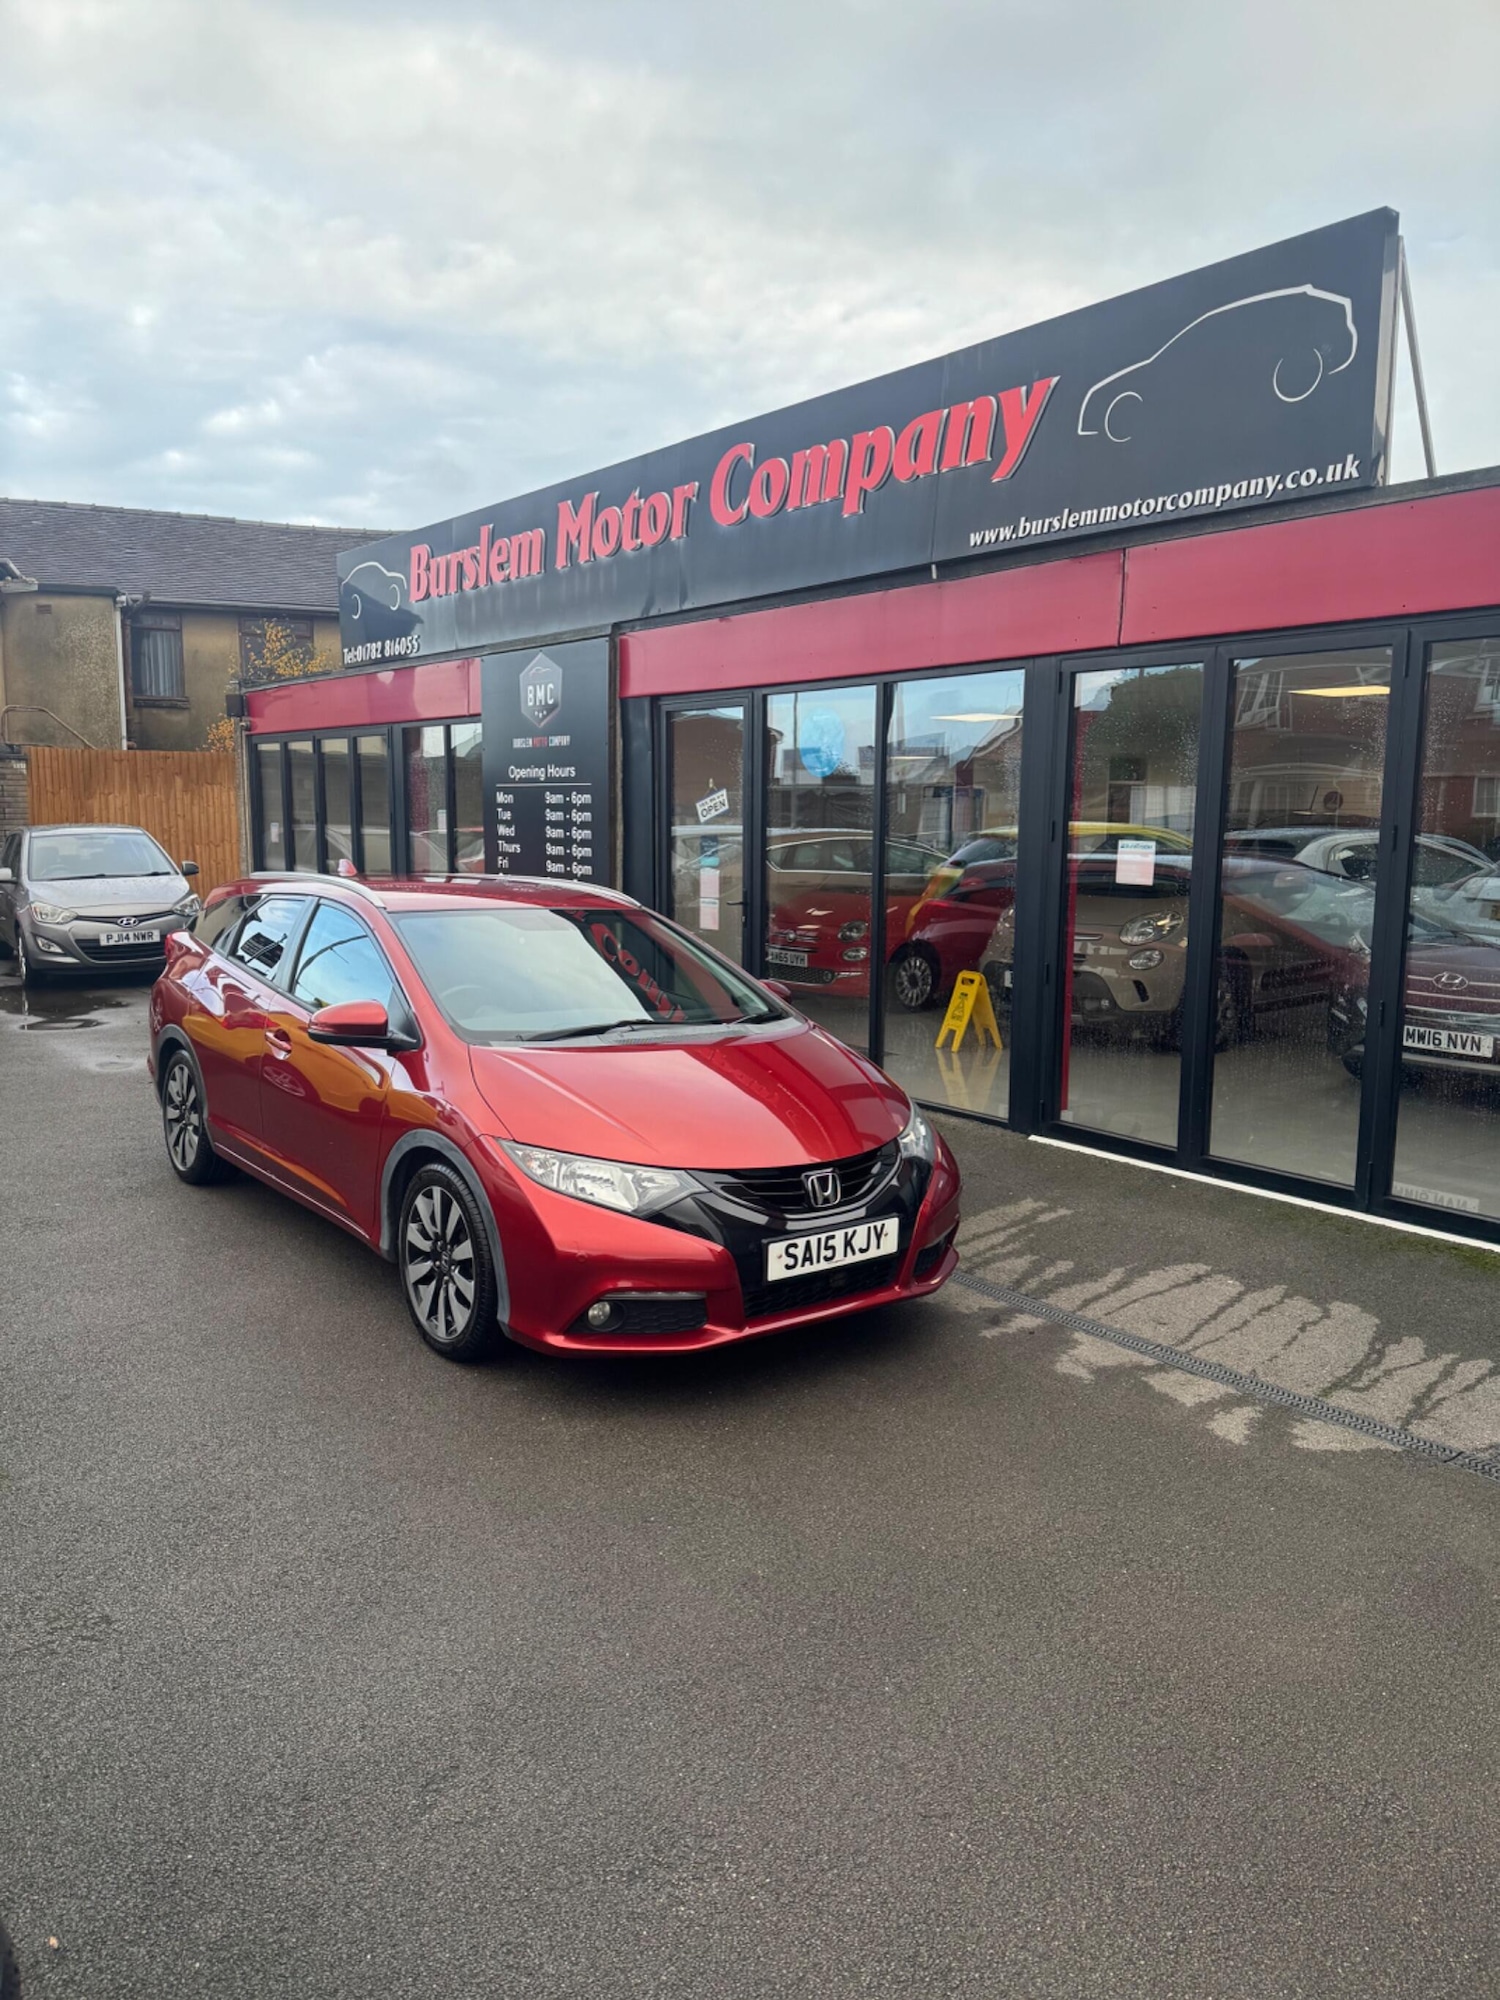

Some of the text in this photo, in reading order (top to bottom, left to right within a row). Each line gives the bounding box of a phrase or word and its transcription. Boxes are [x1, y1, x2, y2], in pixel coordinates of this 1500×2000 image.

[409, 375, 1060, 603] Burslem Motor Company
[969, 453, 1361, 547] www.burslemmotorcompany.co.uk
[384, 635, 419, 657] 816055
[527, 683, 554, 706] BMC
[508, 764, 576, 781] Opening Hours
[496, 791, 514, 804] Mon
[545, 791, 564, 804] 9am
[571, 791, 592, 806] 6pm
[700, 799, 726, 817] OPEN
[496, 808, 512, 820] Tue
[545, 808, 564, 821] 9am
[571, 809, 592, 825] 6pm
[497, 824, 515, 836] Wed
[545, 826, 564, 838] 9am
[571, 826, 592, 842] 6pm
[497, 840, 521, 853] Thurs
[545, 843, 565, 856] 9am
[571, 844, 592, 860] 6pm
[498, 856, 509, 869] Fri
[546, 860, 565, 873] 9am
[571, 862, 593, 878] 6pm
[106, 931, 154, 943] PJ14 NWR
[1405, 1027, 1481, 1052] MW16 NVN
[784, 1223, 885, 1271] SA15 KJY
